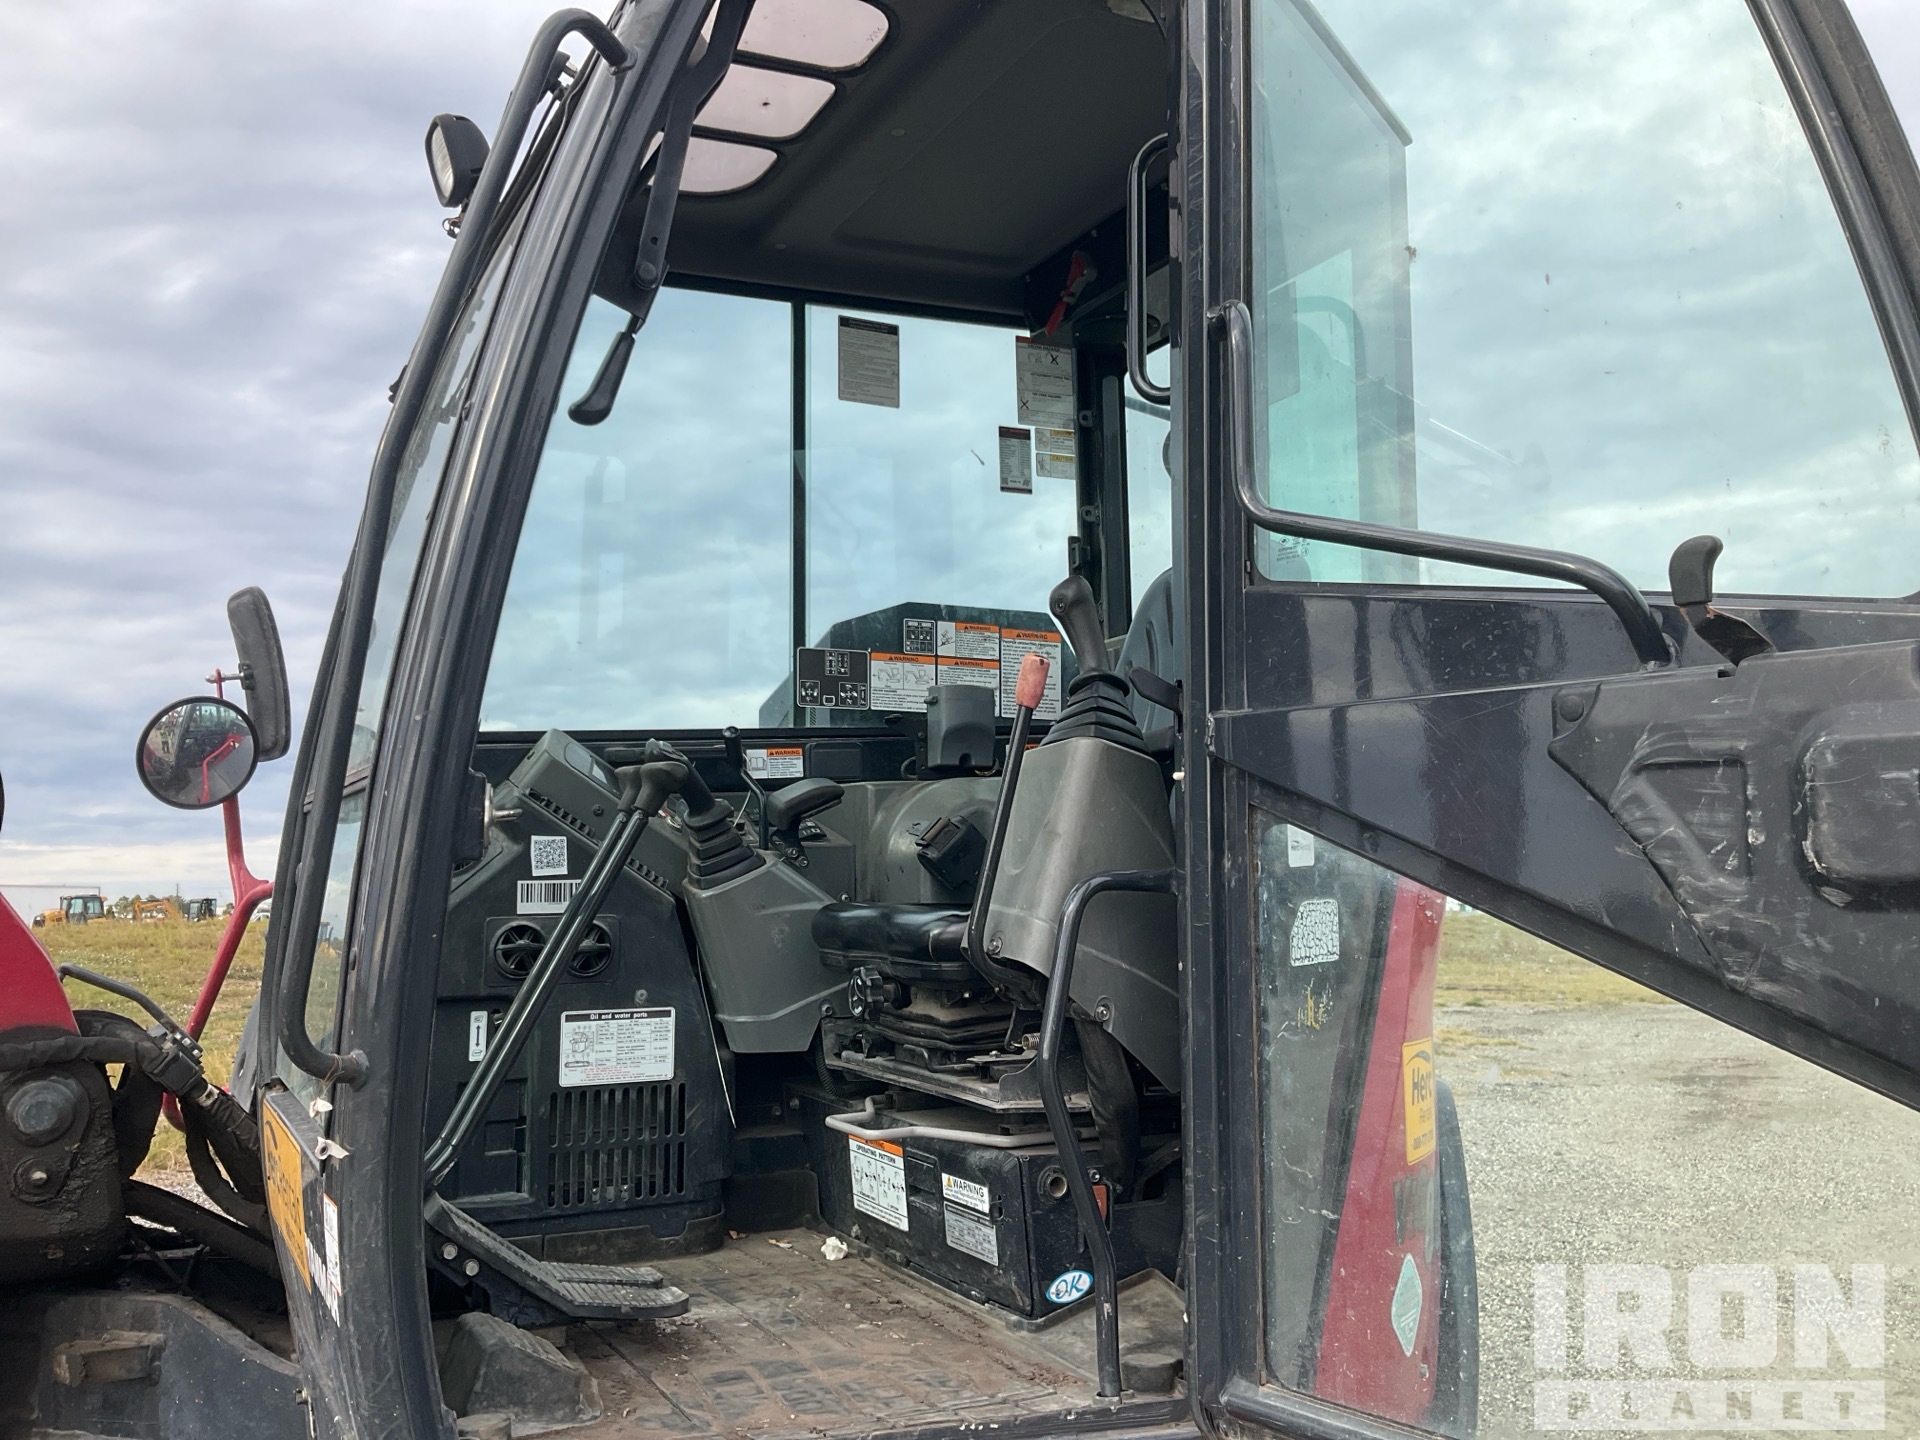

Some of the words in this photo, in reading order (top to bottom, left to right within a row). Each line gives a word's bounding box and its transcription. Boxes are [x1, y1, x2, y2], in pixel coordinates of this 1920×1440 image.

[1021, 632, 1048, 640] WARNING
[893, 655, 919, 663] WARNING
[1412, 1066, 1433, 1106] Herc
[856, 1144, 877, 1158] OPERATING
[878, 1151, 896, 1164] PATTERN
[953, 1178, 985, 1198] WARNING
[1055, 1273, 1086, 1300] OK
